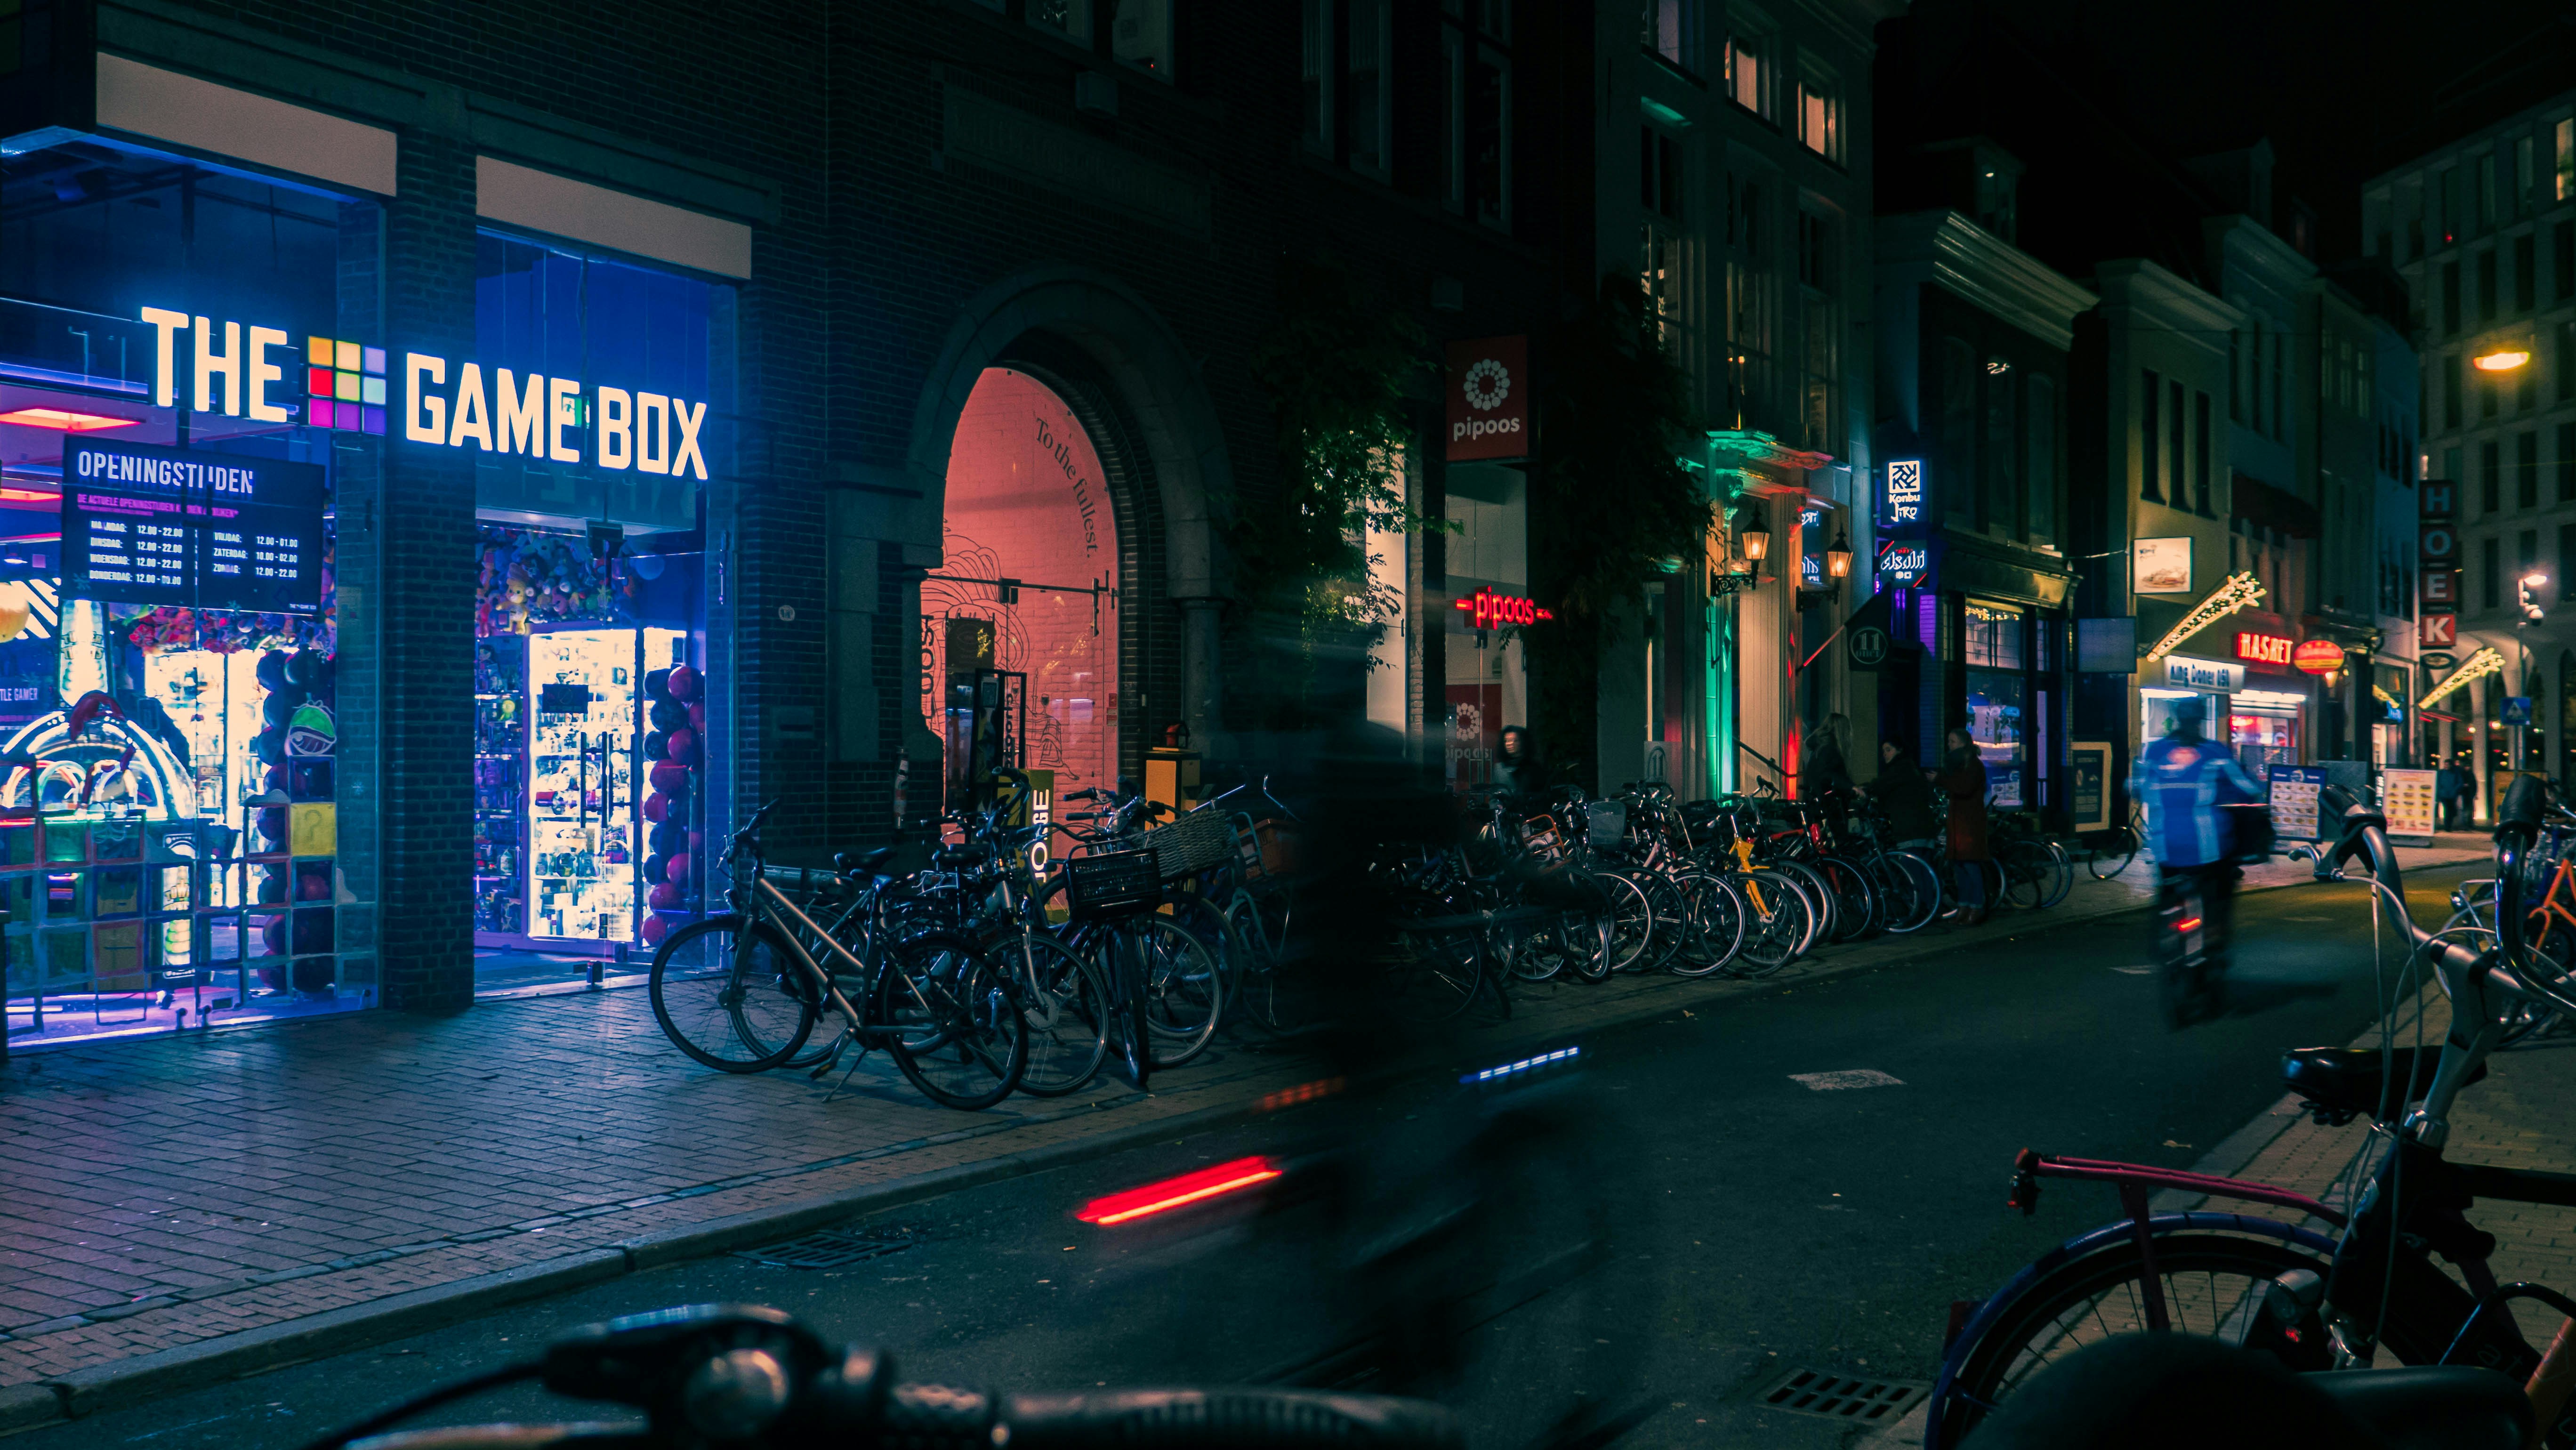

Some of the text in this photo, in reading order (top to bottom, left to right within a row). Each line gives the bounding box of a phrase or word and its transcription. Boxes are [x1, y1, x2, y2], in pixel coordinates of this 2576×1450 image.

[141, 306, 708, 480] THE GAME BOX
[1453, 416, 1520, 442] pipoos
[1036, 417, 1098, 558] To the fullest.
[137, 524, 157, 536] 12.00
[163, 527, 183, 538] 22.00
[137, 541, 157, 551] 12.00
[162, 543, 183, 554] 22.00
[257, 536, 274, 546] 12.00
[280, 538, 298, 548] 01.00
[256, 551, 274, 561] 10.00
[136, 557, 156, 568] 12.00
[162, 559, 182, 570] 22.00
[2425, 487, 2452, 643] HOEK
[136, 573, 156, 583] 12.00
[256, 567, 274, 577] 12.00
[279, 568, 297, 579] 22.00
[1476, 585, 1534, 631] pipoos
[14, 687, 38, 701] GAMER
[1030, 788, 1050, 884] JOGE
